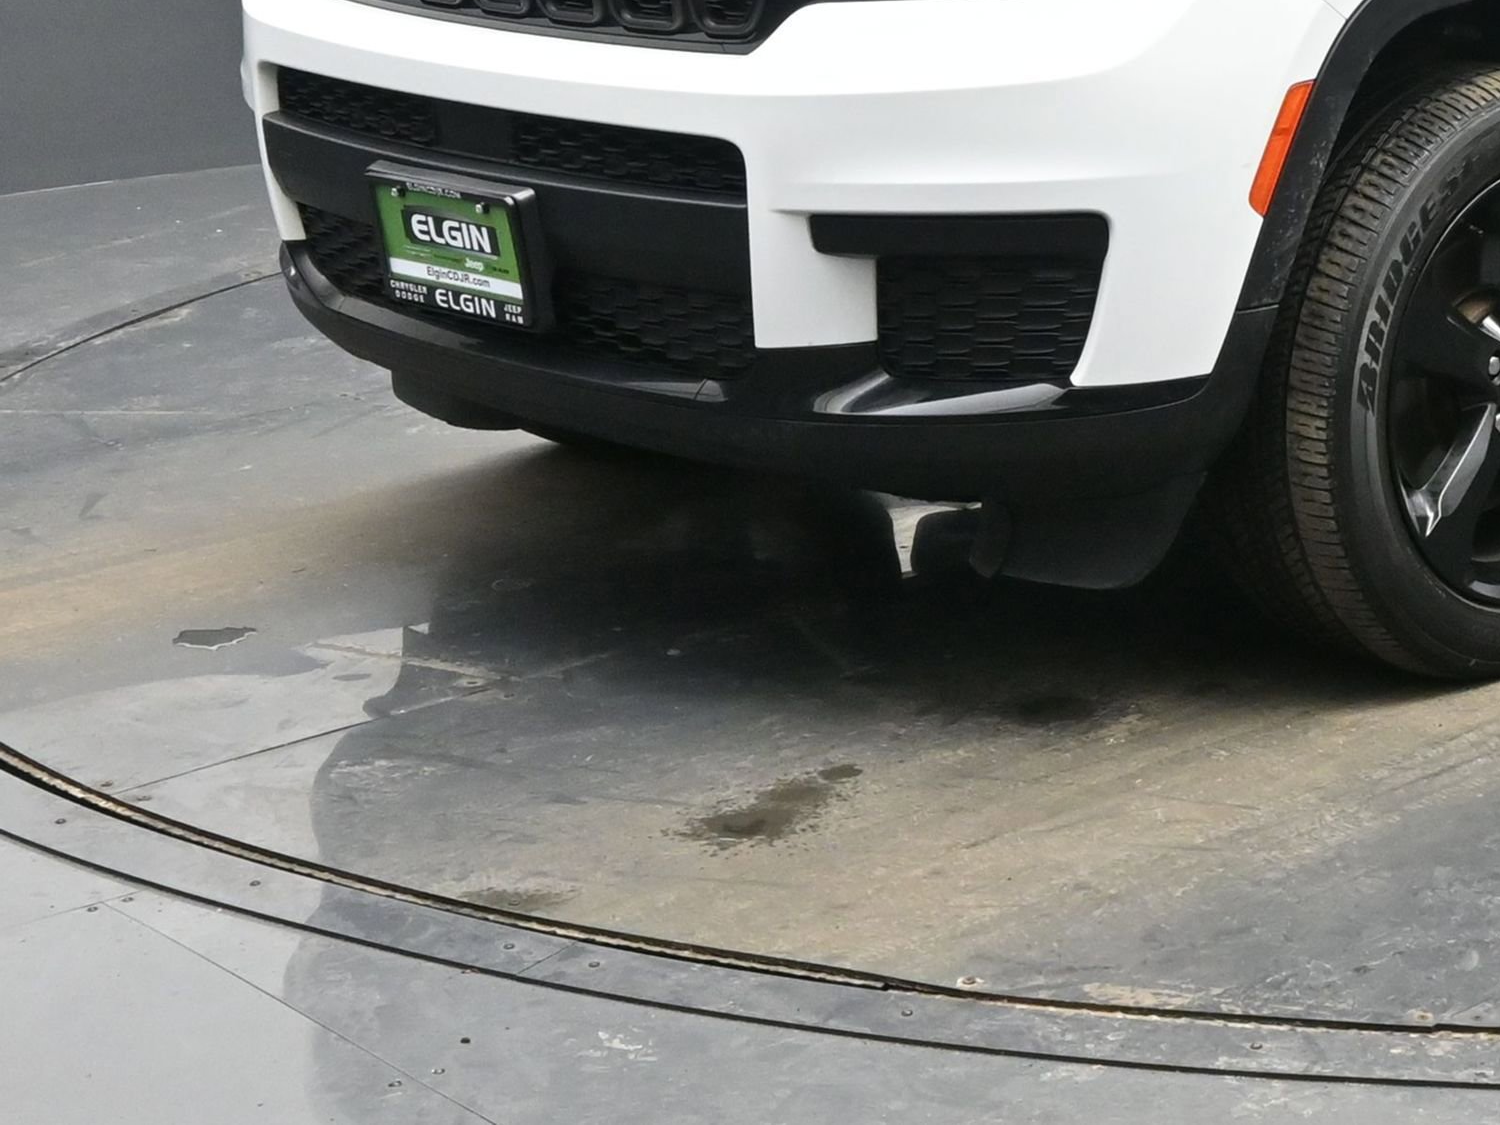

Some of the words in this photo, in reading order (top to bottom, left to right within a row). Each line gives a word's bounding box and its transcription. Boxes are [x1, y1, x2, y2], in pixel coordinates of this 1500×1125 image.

[410, 213, 492, 254] ELGIN
[389, 279, 428, 295] CHRYSLER
[426, 266, 491, 288] ElginCDJR.com
[394, 289, 425, 303] DODGE
[434, 288, 497, 319] ELGIN
